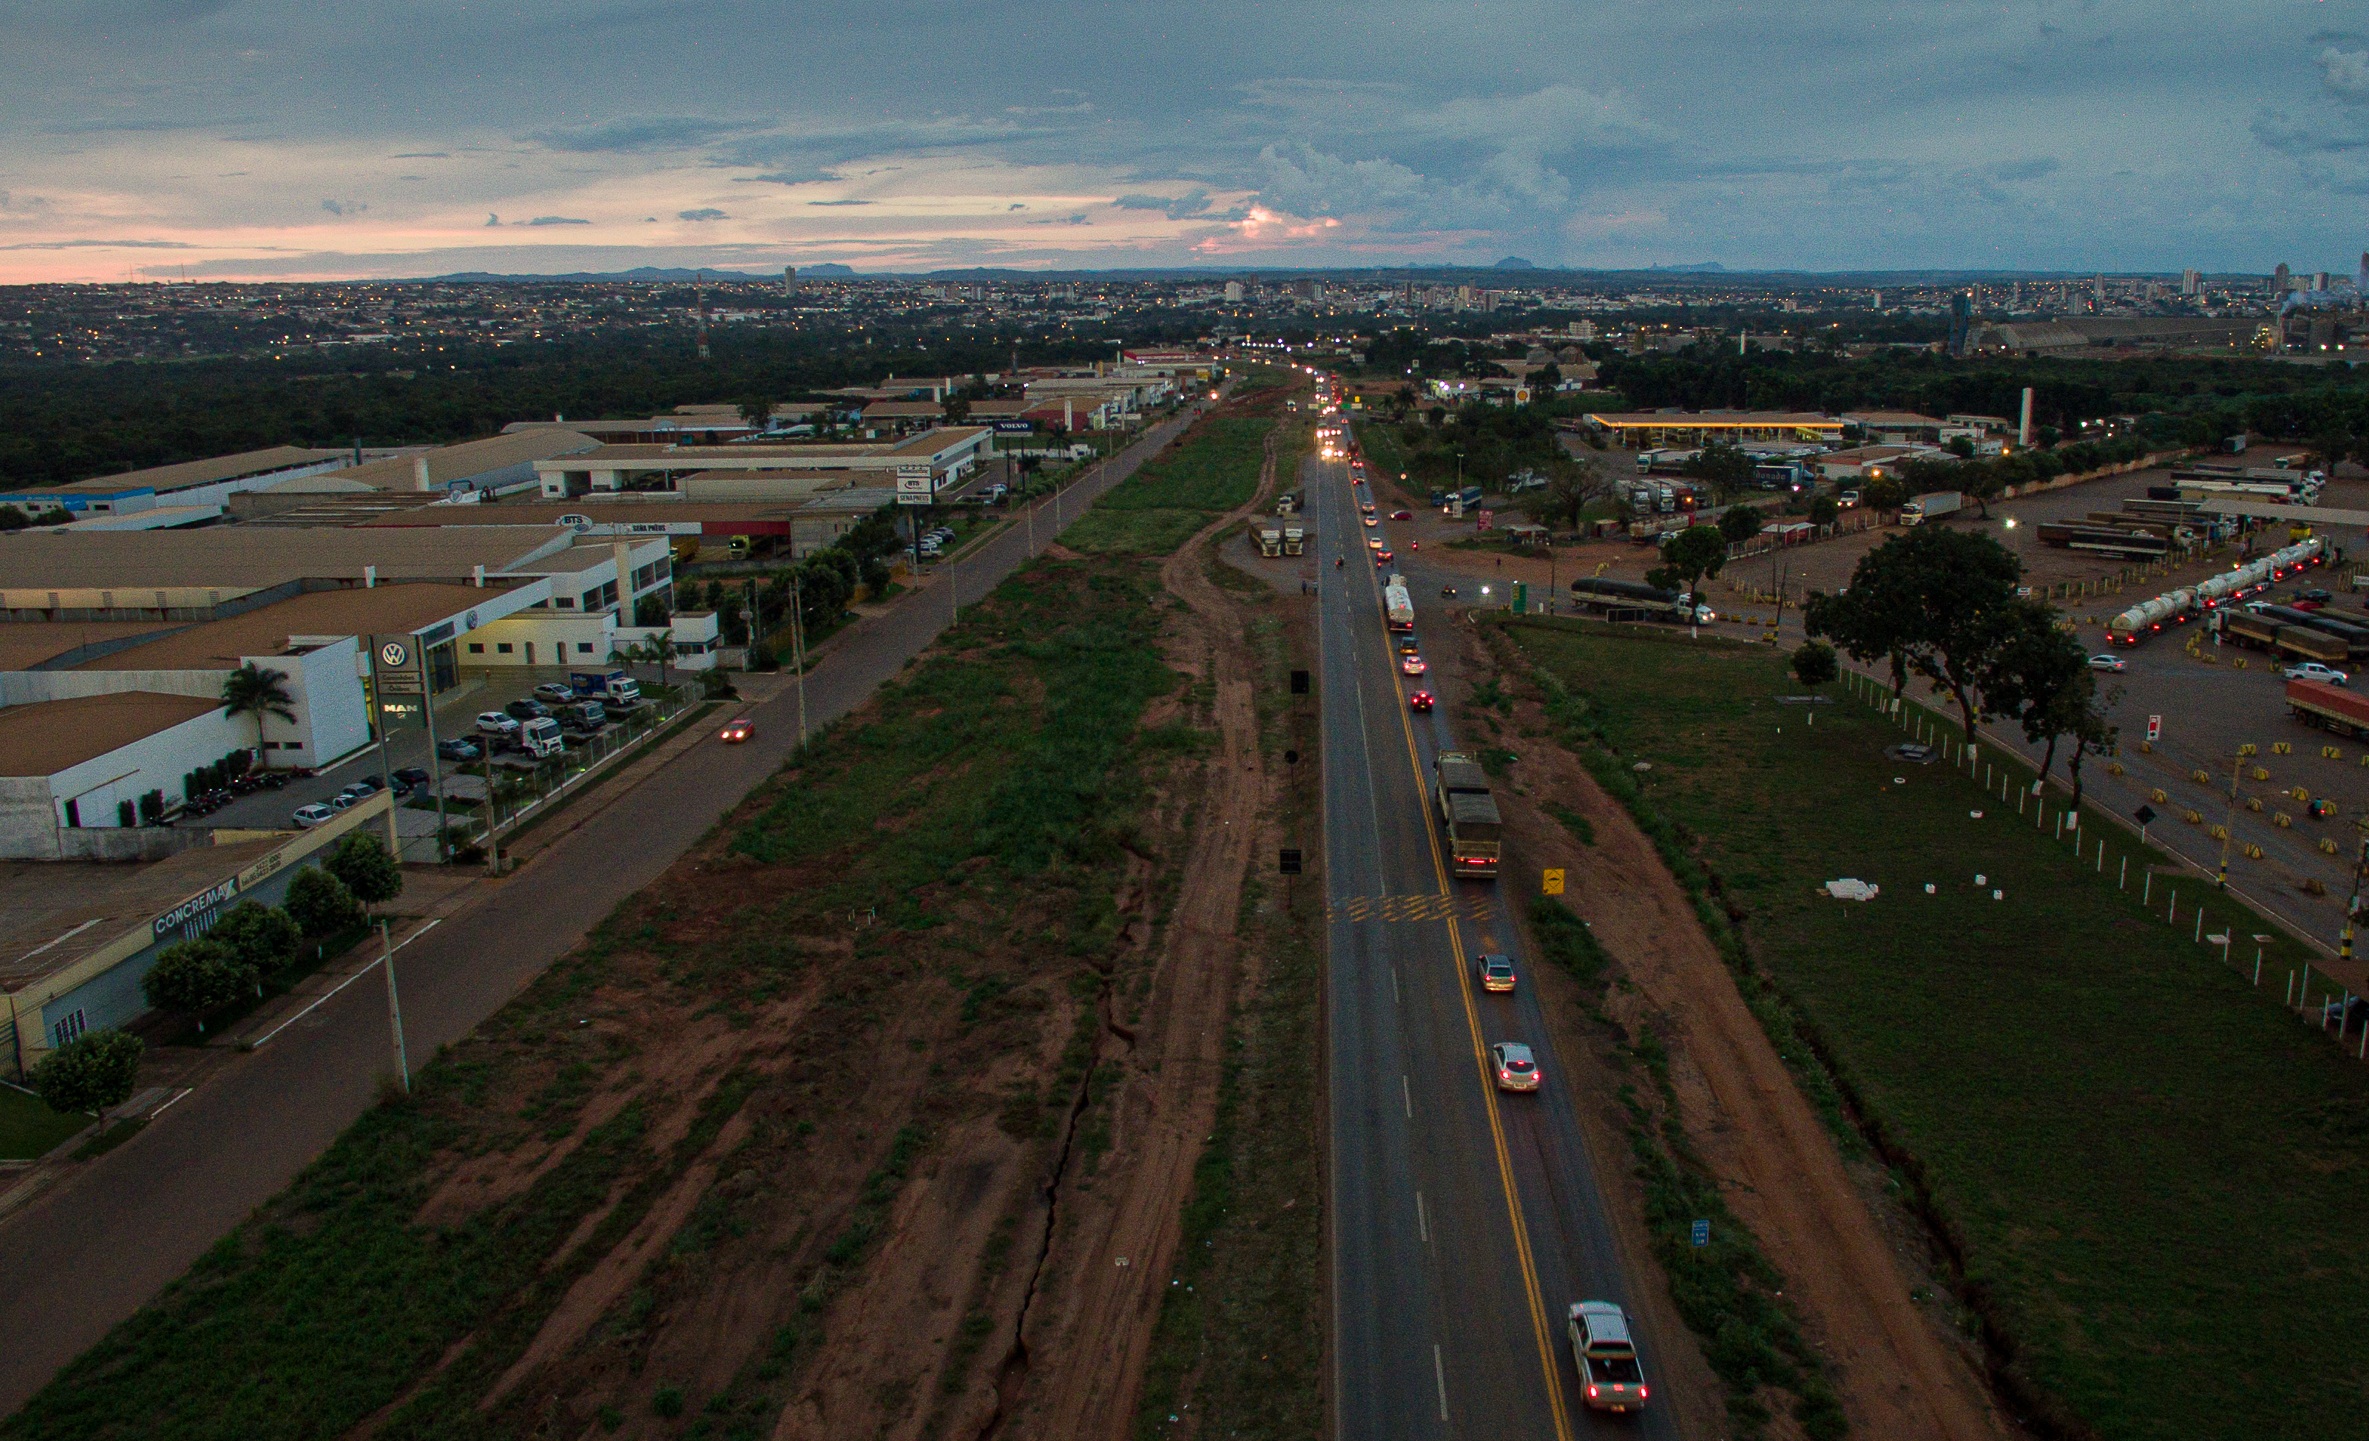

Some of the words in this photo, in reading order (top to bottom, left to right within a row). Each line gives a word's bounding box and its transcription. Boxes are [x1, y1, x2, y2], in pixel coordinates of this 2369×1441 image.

[564, 515, 583, 523] BTS
[383, 704, 418, 712] MAN
[155, 879, 237, 934] CONCREMAX
